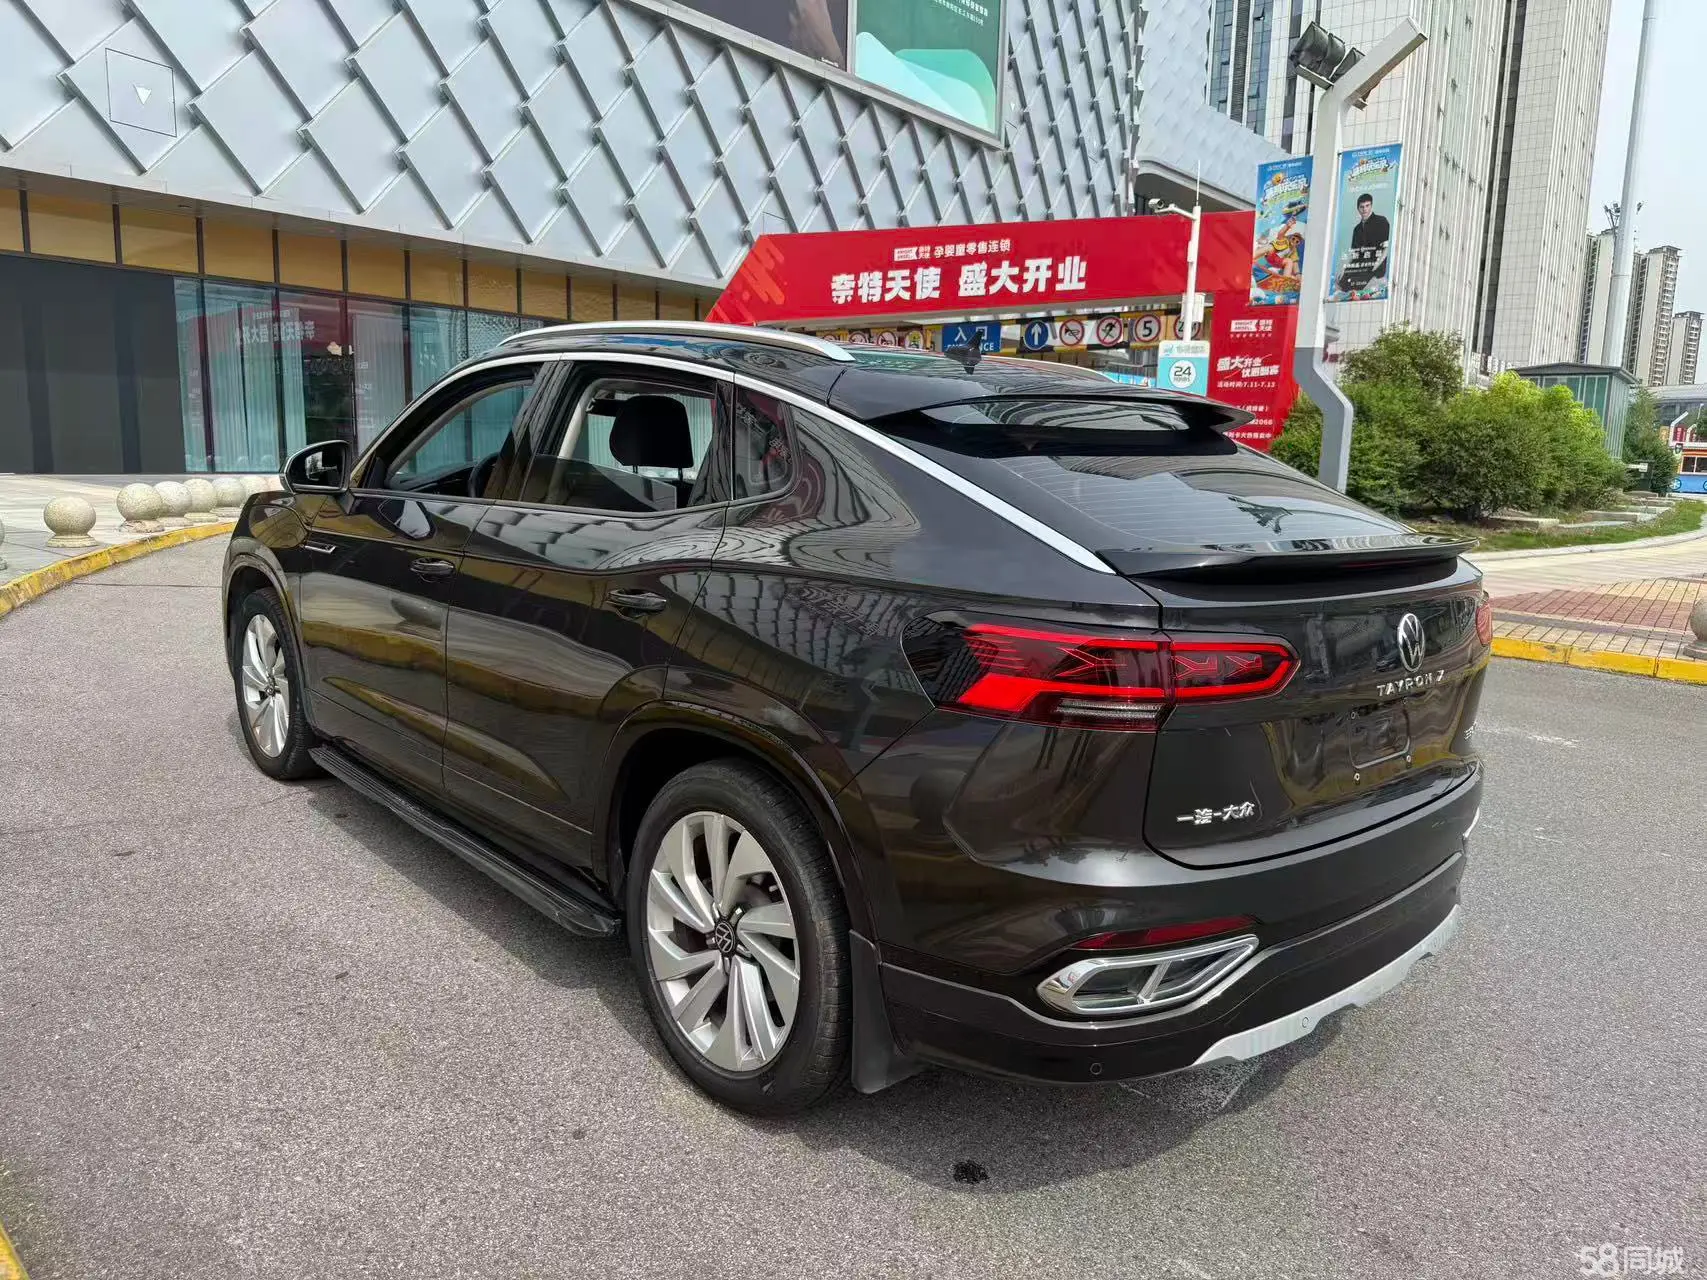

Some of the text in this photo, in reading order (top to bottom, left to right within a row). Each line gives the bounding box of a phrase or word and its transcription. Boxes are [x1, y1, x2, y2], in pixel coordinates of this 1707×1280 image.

[934, 238, 1011, 258] 孕婴童零售连锁
[831, 255, 1088, 304] 奈特天使 盛大开业
[1143, 320, 1153, 338] 5
[1174, 366, 1192, 377] 24
[1216, 356, 1262, 372] 盛大开业
[1377, 669, 1445, 696] TAYRON 7
